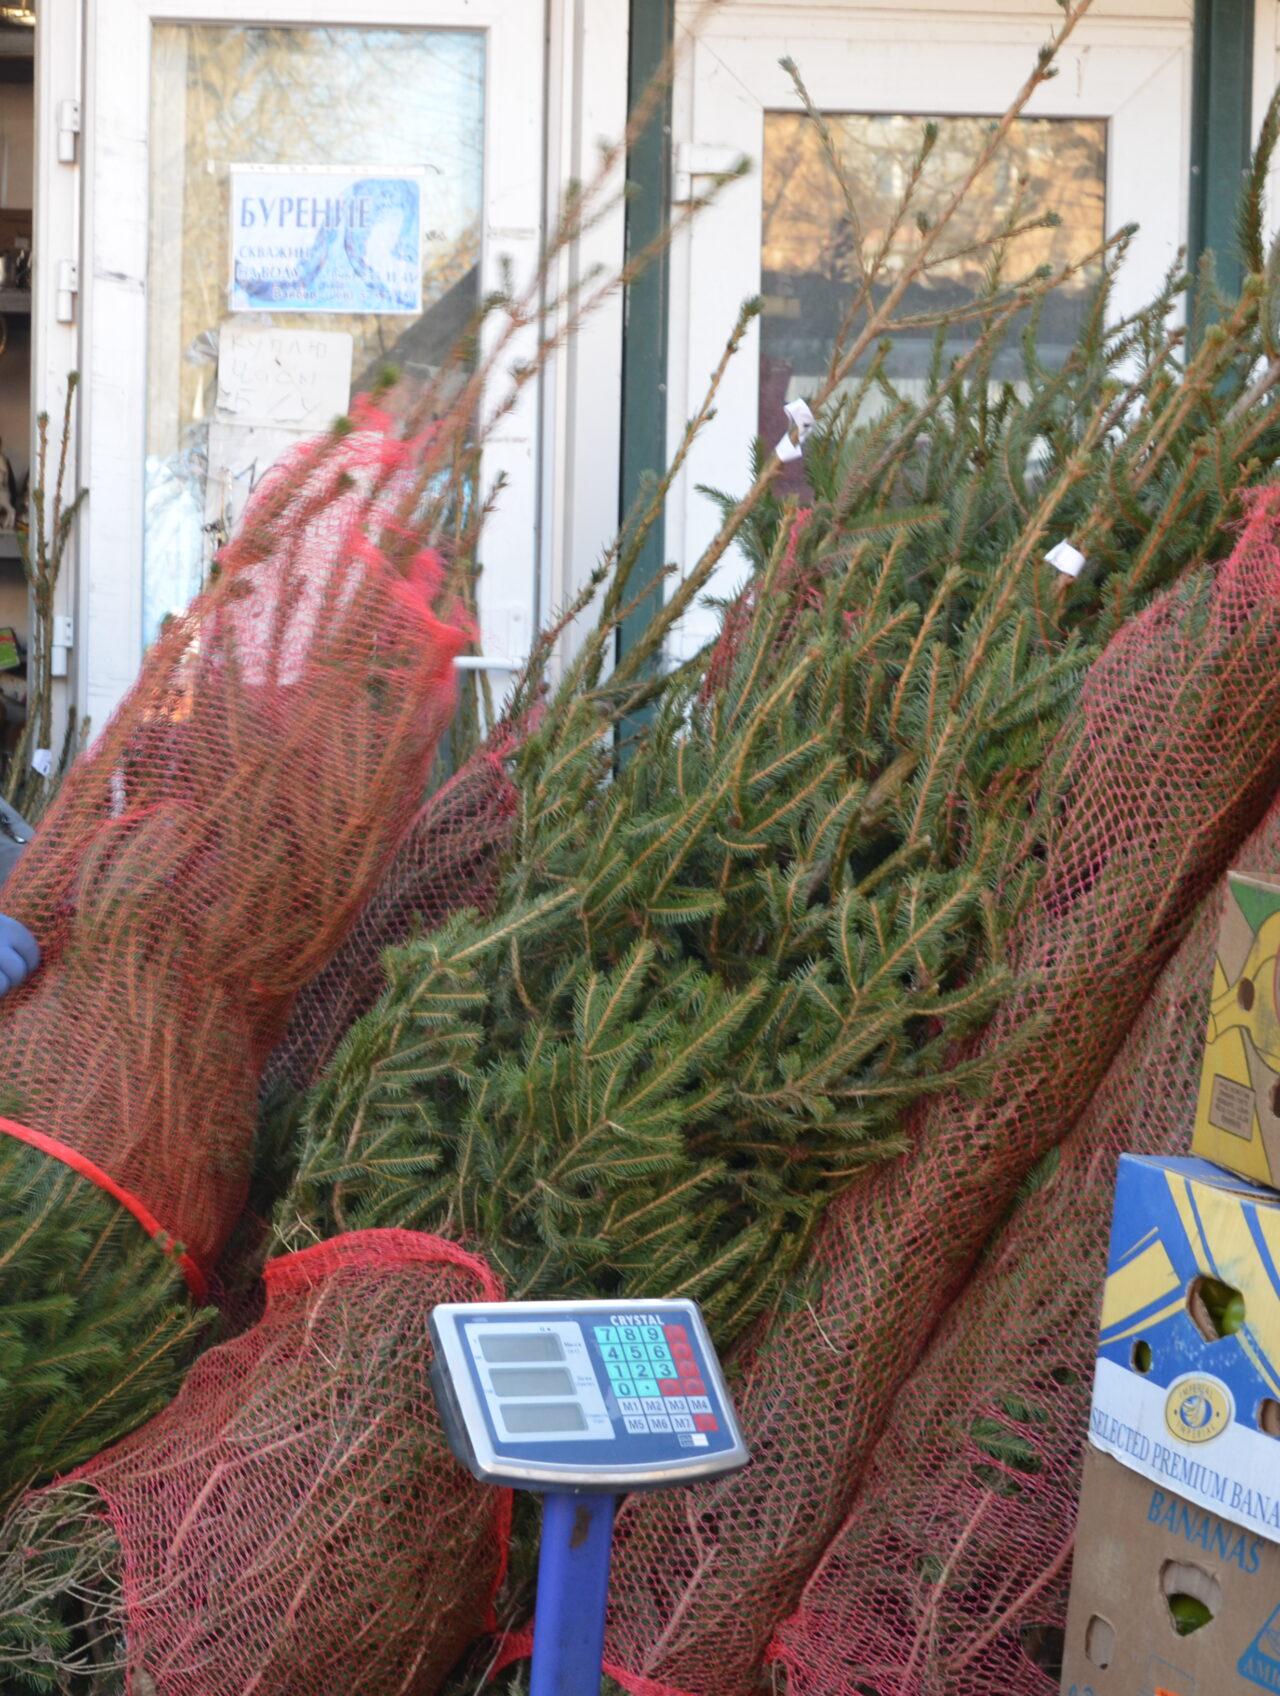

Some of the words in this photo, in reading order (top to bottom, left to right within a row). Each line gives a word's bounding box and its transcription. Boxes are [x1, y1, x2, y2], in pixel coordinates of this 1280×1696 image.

[240, 197, 370, 228] БУРЕНИЕ
[610, 1314, 664, 1326] CRYSTAL
[600, 1328, 610, 1341] 7
[625, 1328, 636, 1341] 8
[647, 1328, 659, 1340] 9
[608, 1347, 619, 1360] 4
[631, 1346, 642, 1359] 5
[653, 1345, 665, 1358] 6
[615, 1366, 623, 1378] 1
[636, 1365, 648, 1377] 2
[660, 1364, 671, 1376] 3
[618, 1383, 630, 1396] 0
[622, 1401, 639, 1411] M1
[645, 1401, 662, 1411] M2
[668, 1400, 685, 1410] M3
[690, 1400, 708, 1409] M4
[628, 1420, 645, 1430] M5
[651, 1419, 669, 1430] M6
[1092, 1408, 1150, 1461] SELECTED
[1152, 1442, 1228, 1503] PREMIUM
[1147, 1489, 1263, 1574] BANANAS
